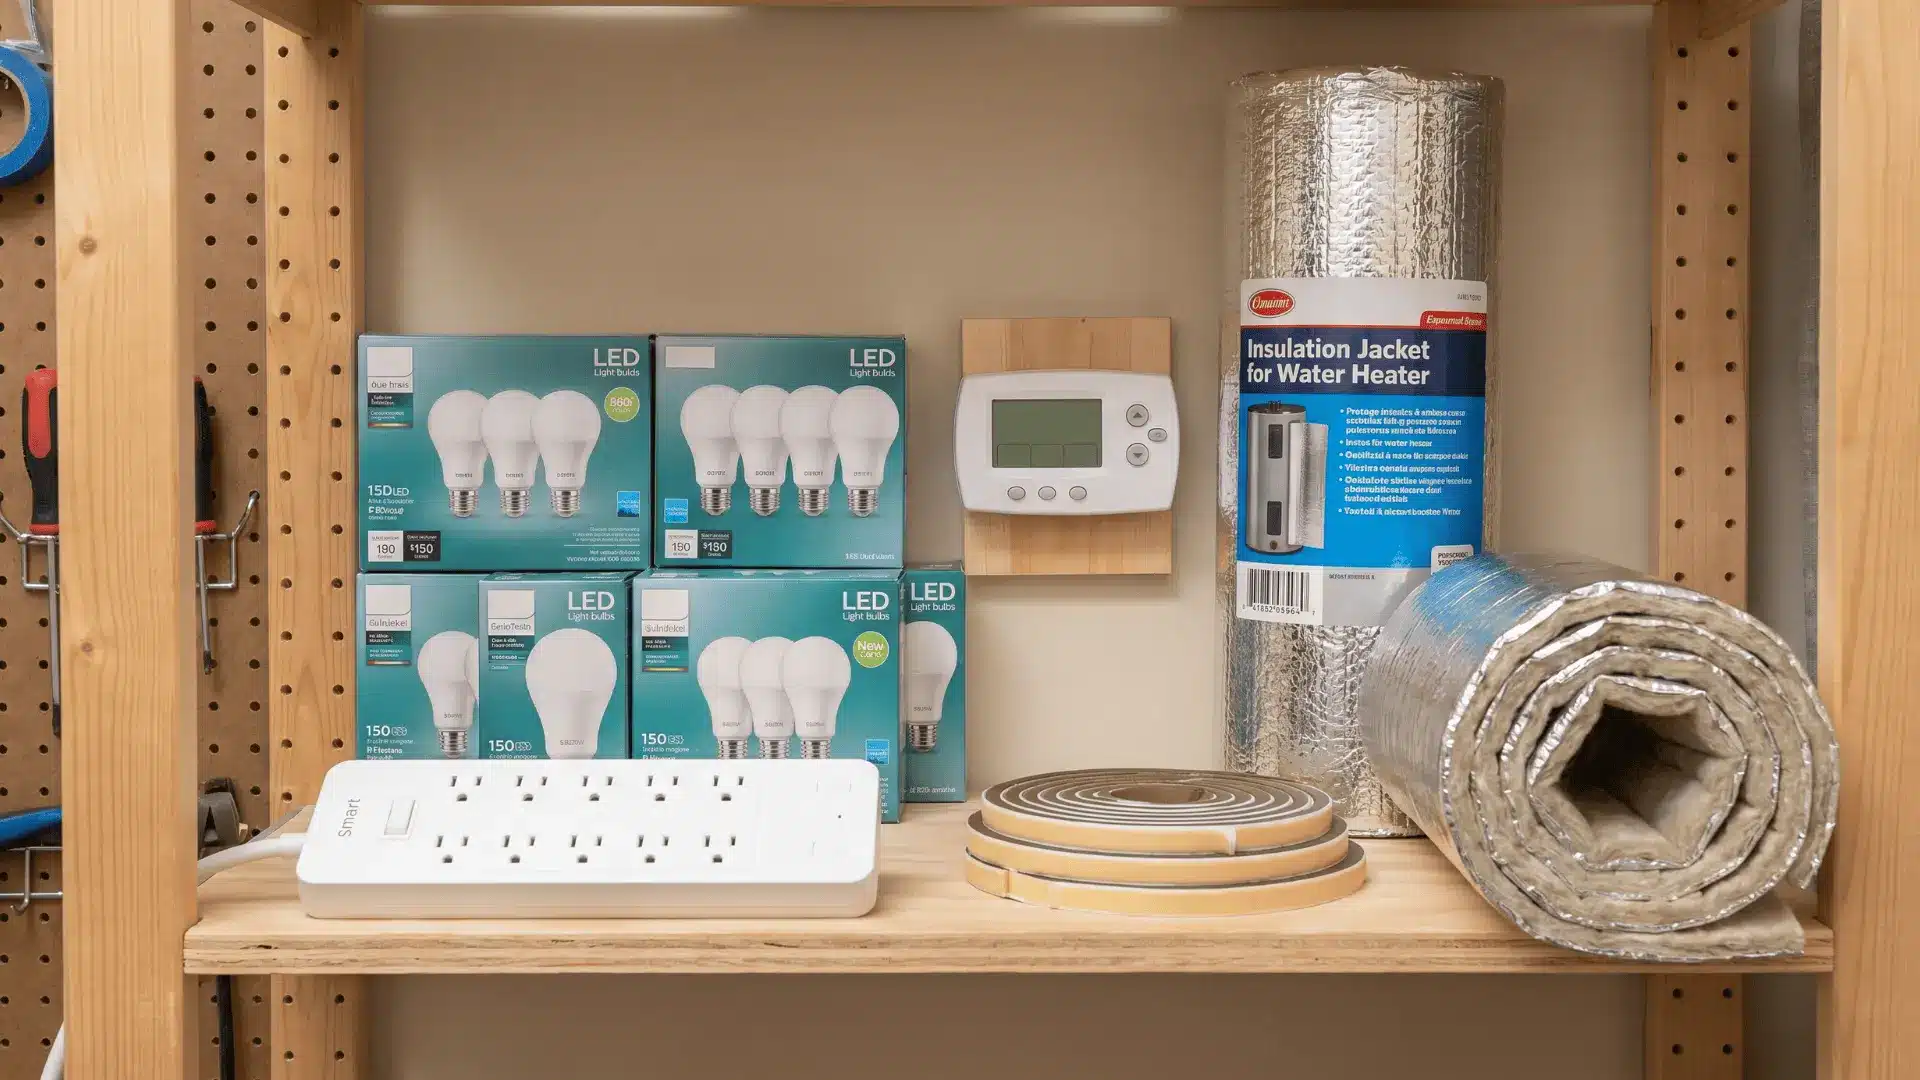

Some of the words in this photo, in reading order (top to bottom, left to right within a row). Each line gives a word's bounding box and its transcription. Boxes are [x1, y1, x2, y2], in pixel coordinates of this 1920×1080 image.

[1248, 337, 1350, 359] Insulation
[1357, 339, 1430, 360] Jacket
[594, 348, 640, 366] LED
[850, 348, 896, 367] LED
[594, 369, 616, 377] Light
[850, 369, 871, 378] Light
[1247, 362, 1272, 382] for
[1277, 364, 1346, 384] Water
[1352, 364, 1430, 385] Heater
[911, 583, 956, 601] LED
[568, 591, 615, 610] LED
[843, 591, 890, 611] LED
[911, 603, 932, 612] Light
[933, 603, 956, 611] bulbs
[568, 612, 589, 622] Light
[591, 612, 615, 621] bulbs
[843, 612, 864, 622] Light
[858, 641, 884, 651] New
[366, 725, 390, 737] 150
[641, 733, 667, 745] 150
[488, 740, 514, 752] 150
[337, 798, 361, 837] Smart
